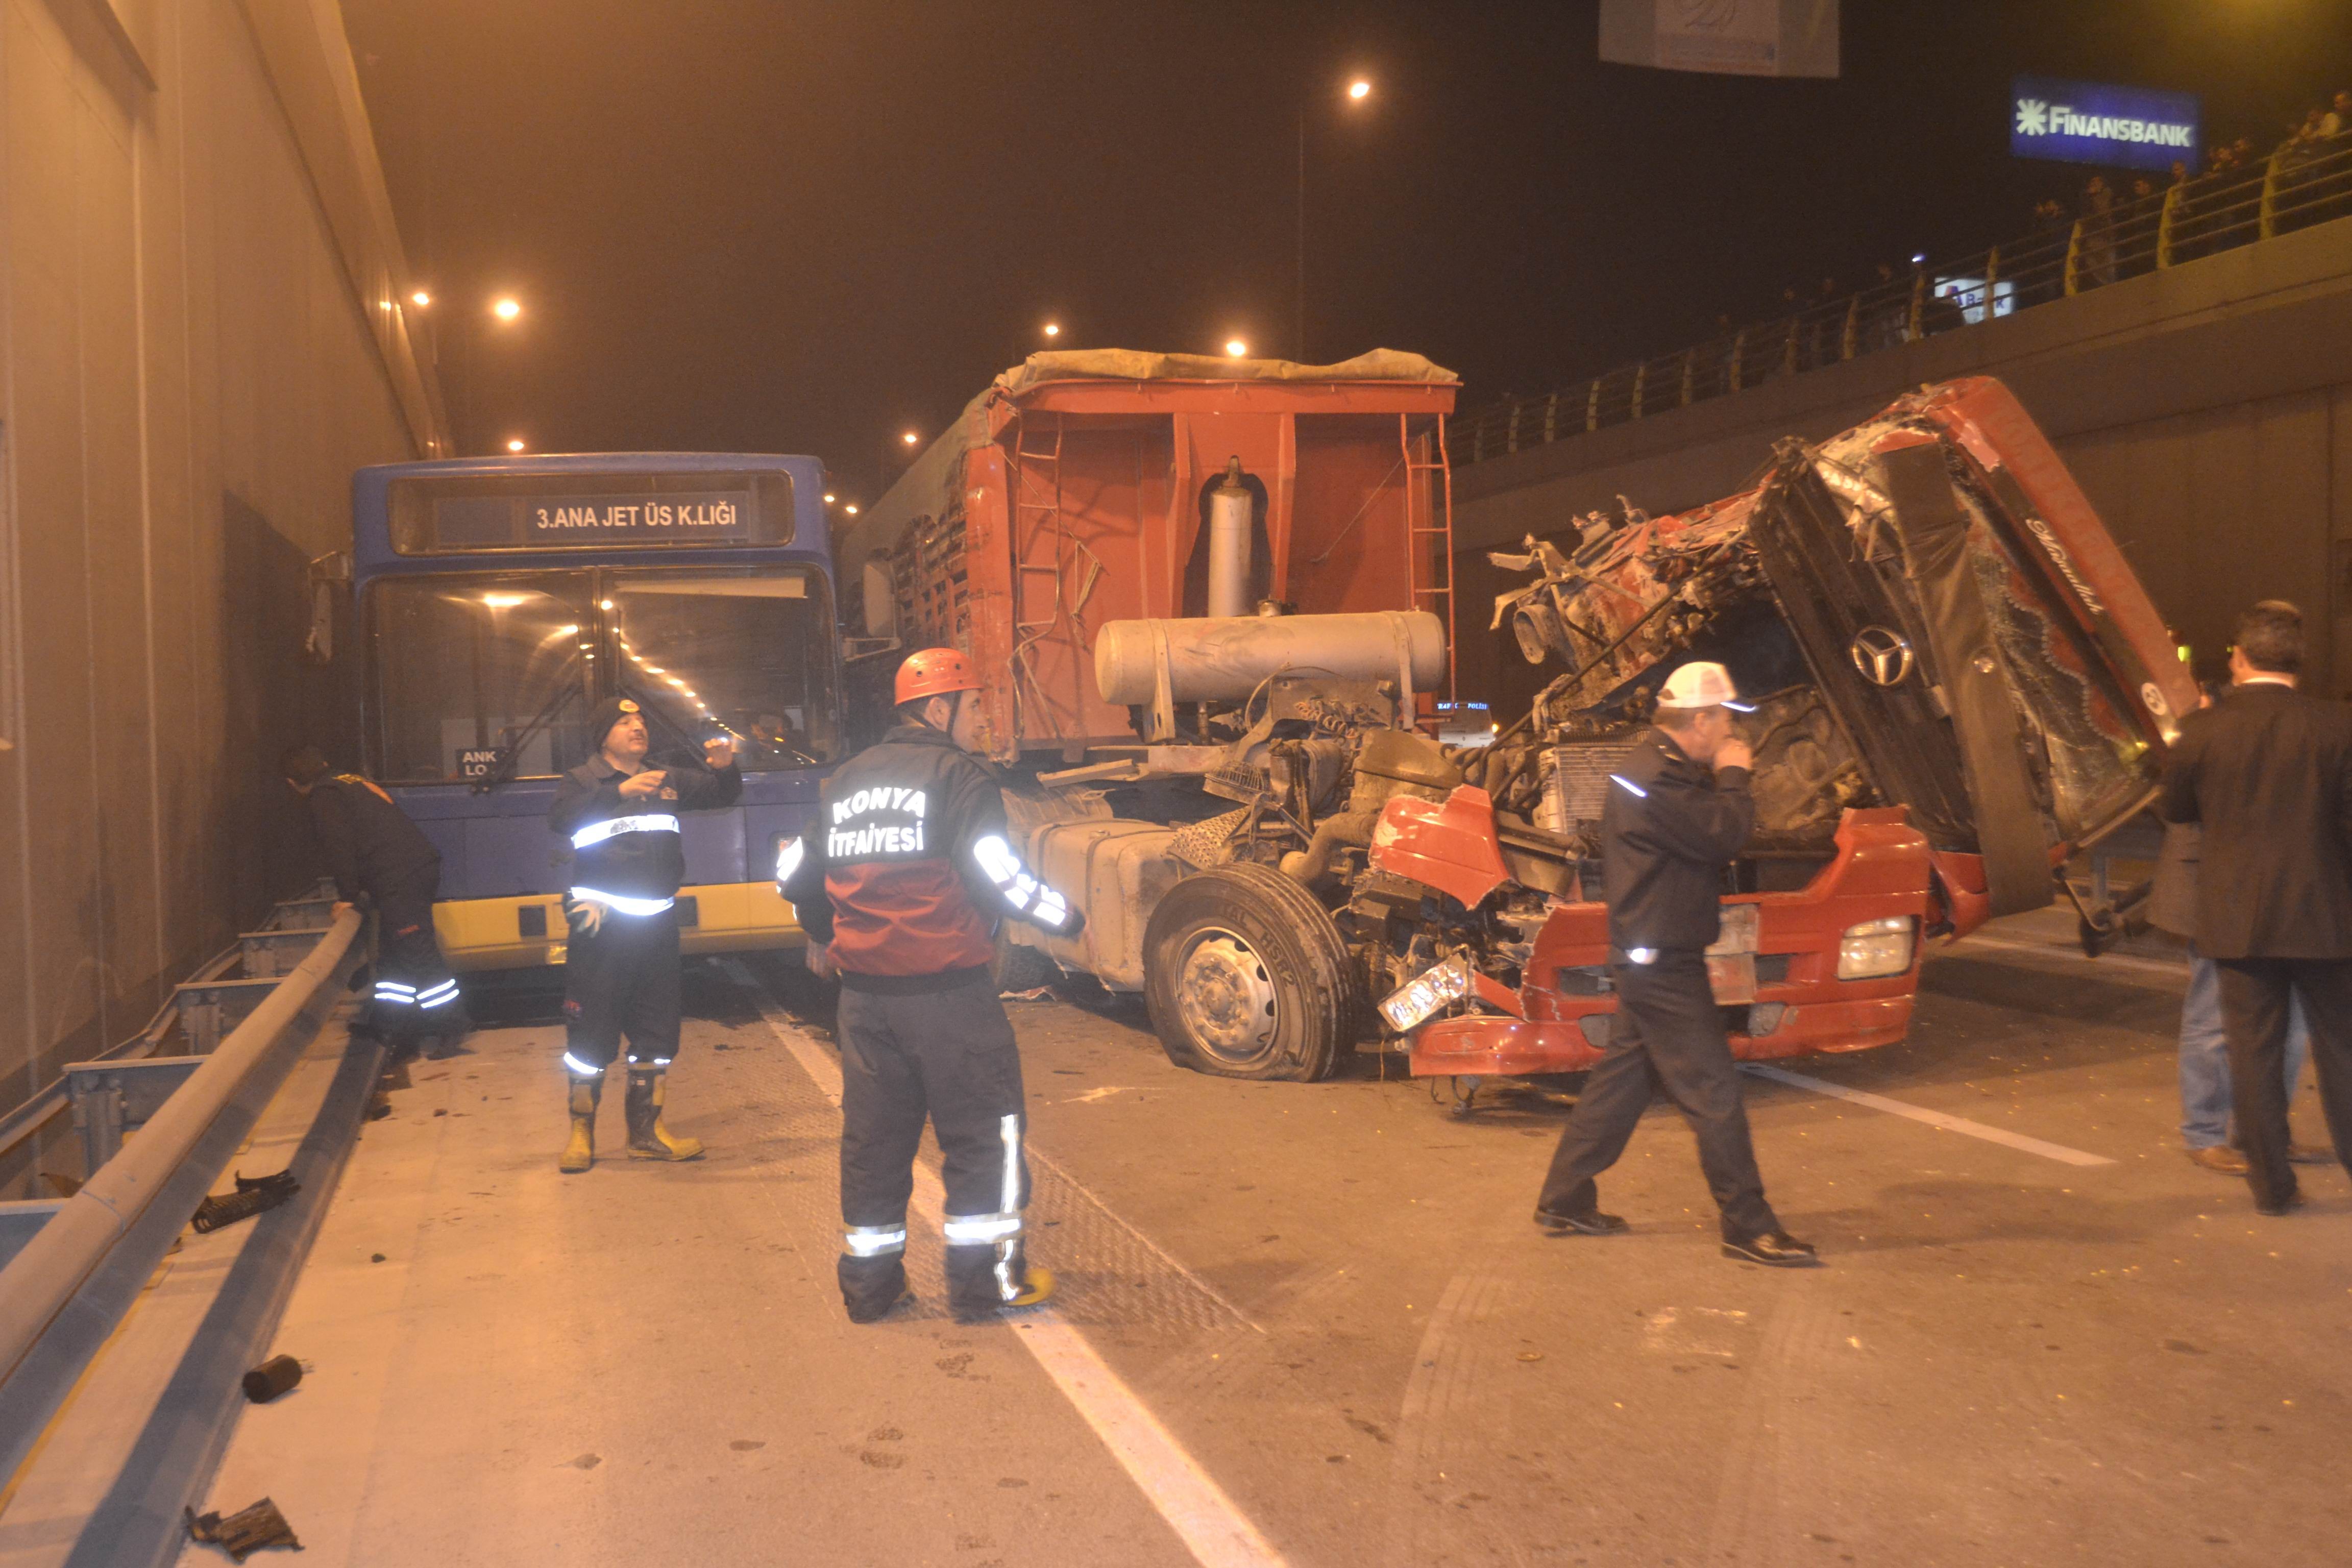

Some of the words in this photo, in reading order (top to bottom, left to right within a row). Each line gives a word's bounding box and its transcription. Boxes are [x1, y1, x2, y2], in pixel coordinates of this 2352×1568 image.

[2049, 106, 2191, 147] FINANSBANK
[536, 507, 598, 528] 3.ANA
[602, 506, 640, 526] JET
[645, 502, 673, 526] ÜS
[462, 751, 497, 763] ANK
[833, 787, 926, 824] KONYA
[828, 820, 924, 857] İTFAİYESİ
